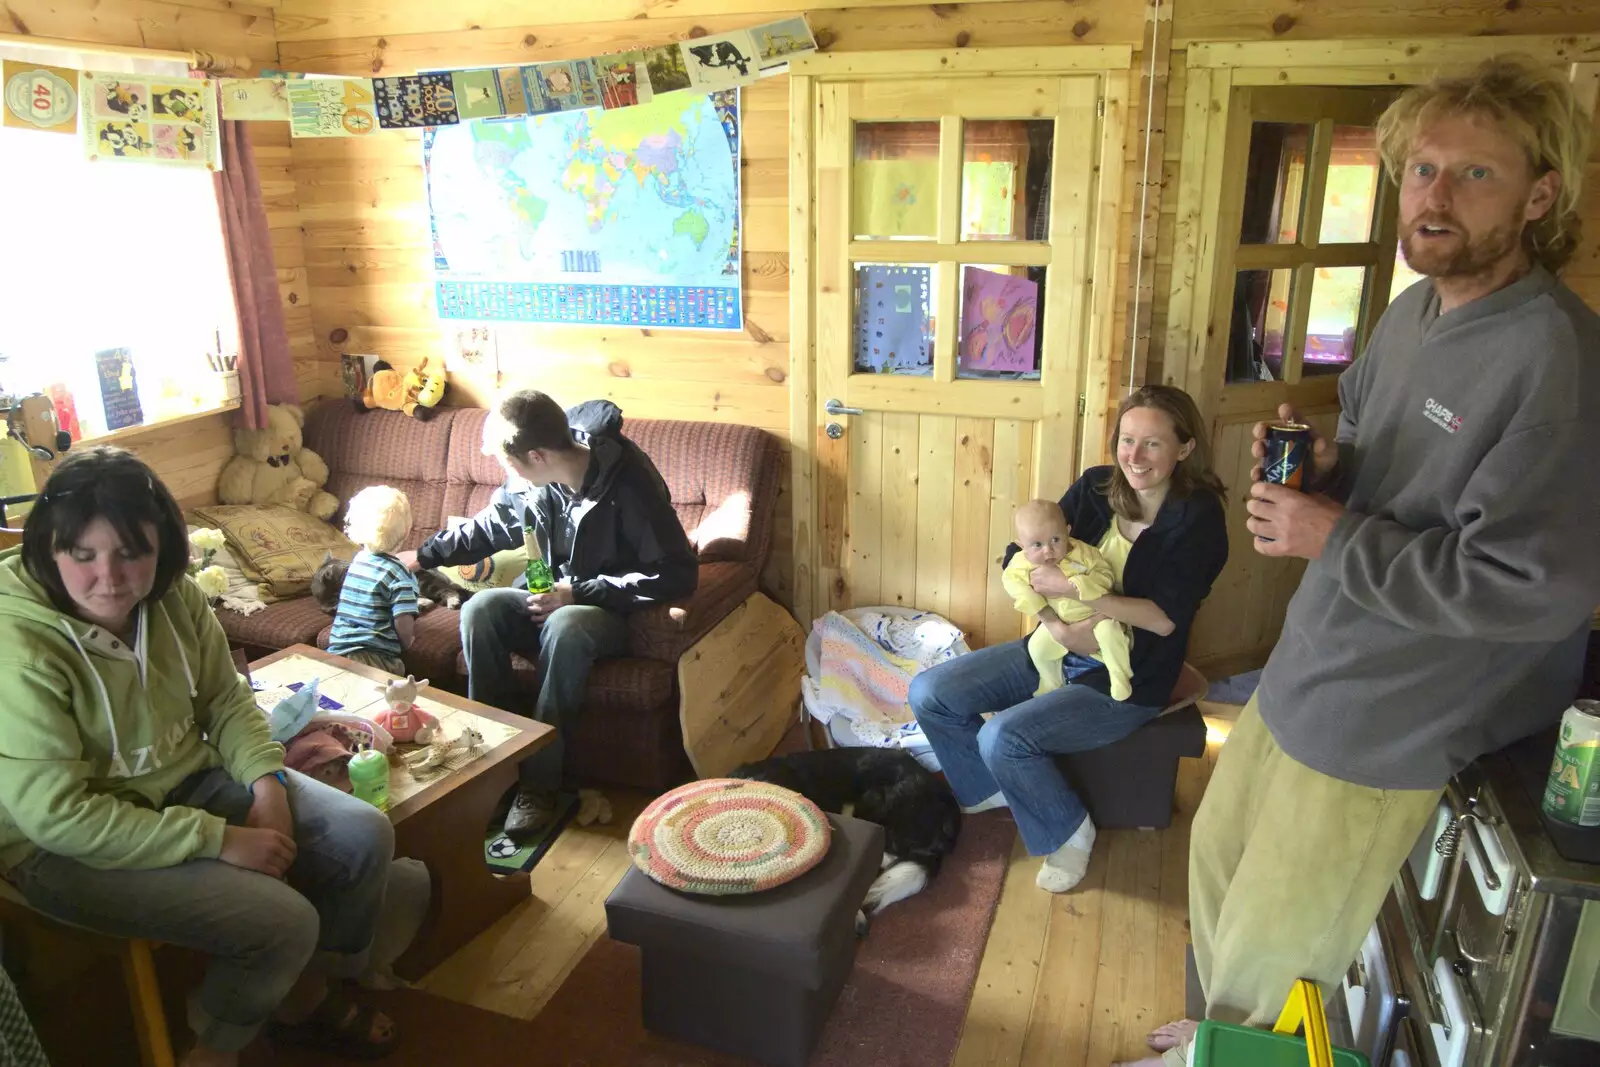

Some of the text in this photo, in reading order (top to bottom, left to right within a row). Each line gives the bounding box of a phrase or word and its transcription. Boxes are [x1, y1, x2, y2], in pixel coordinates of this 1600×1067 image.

[34, 84, 50, 111] 40
[435, 84, 455, 112] 40
[581, 79, 599, 106] 40
[340, 79, 374, 135] 40
